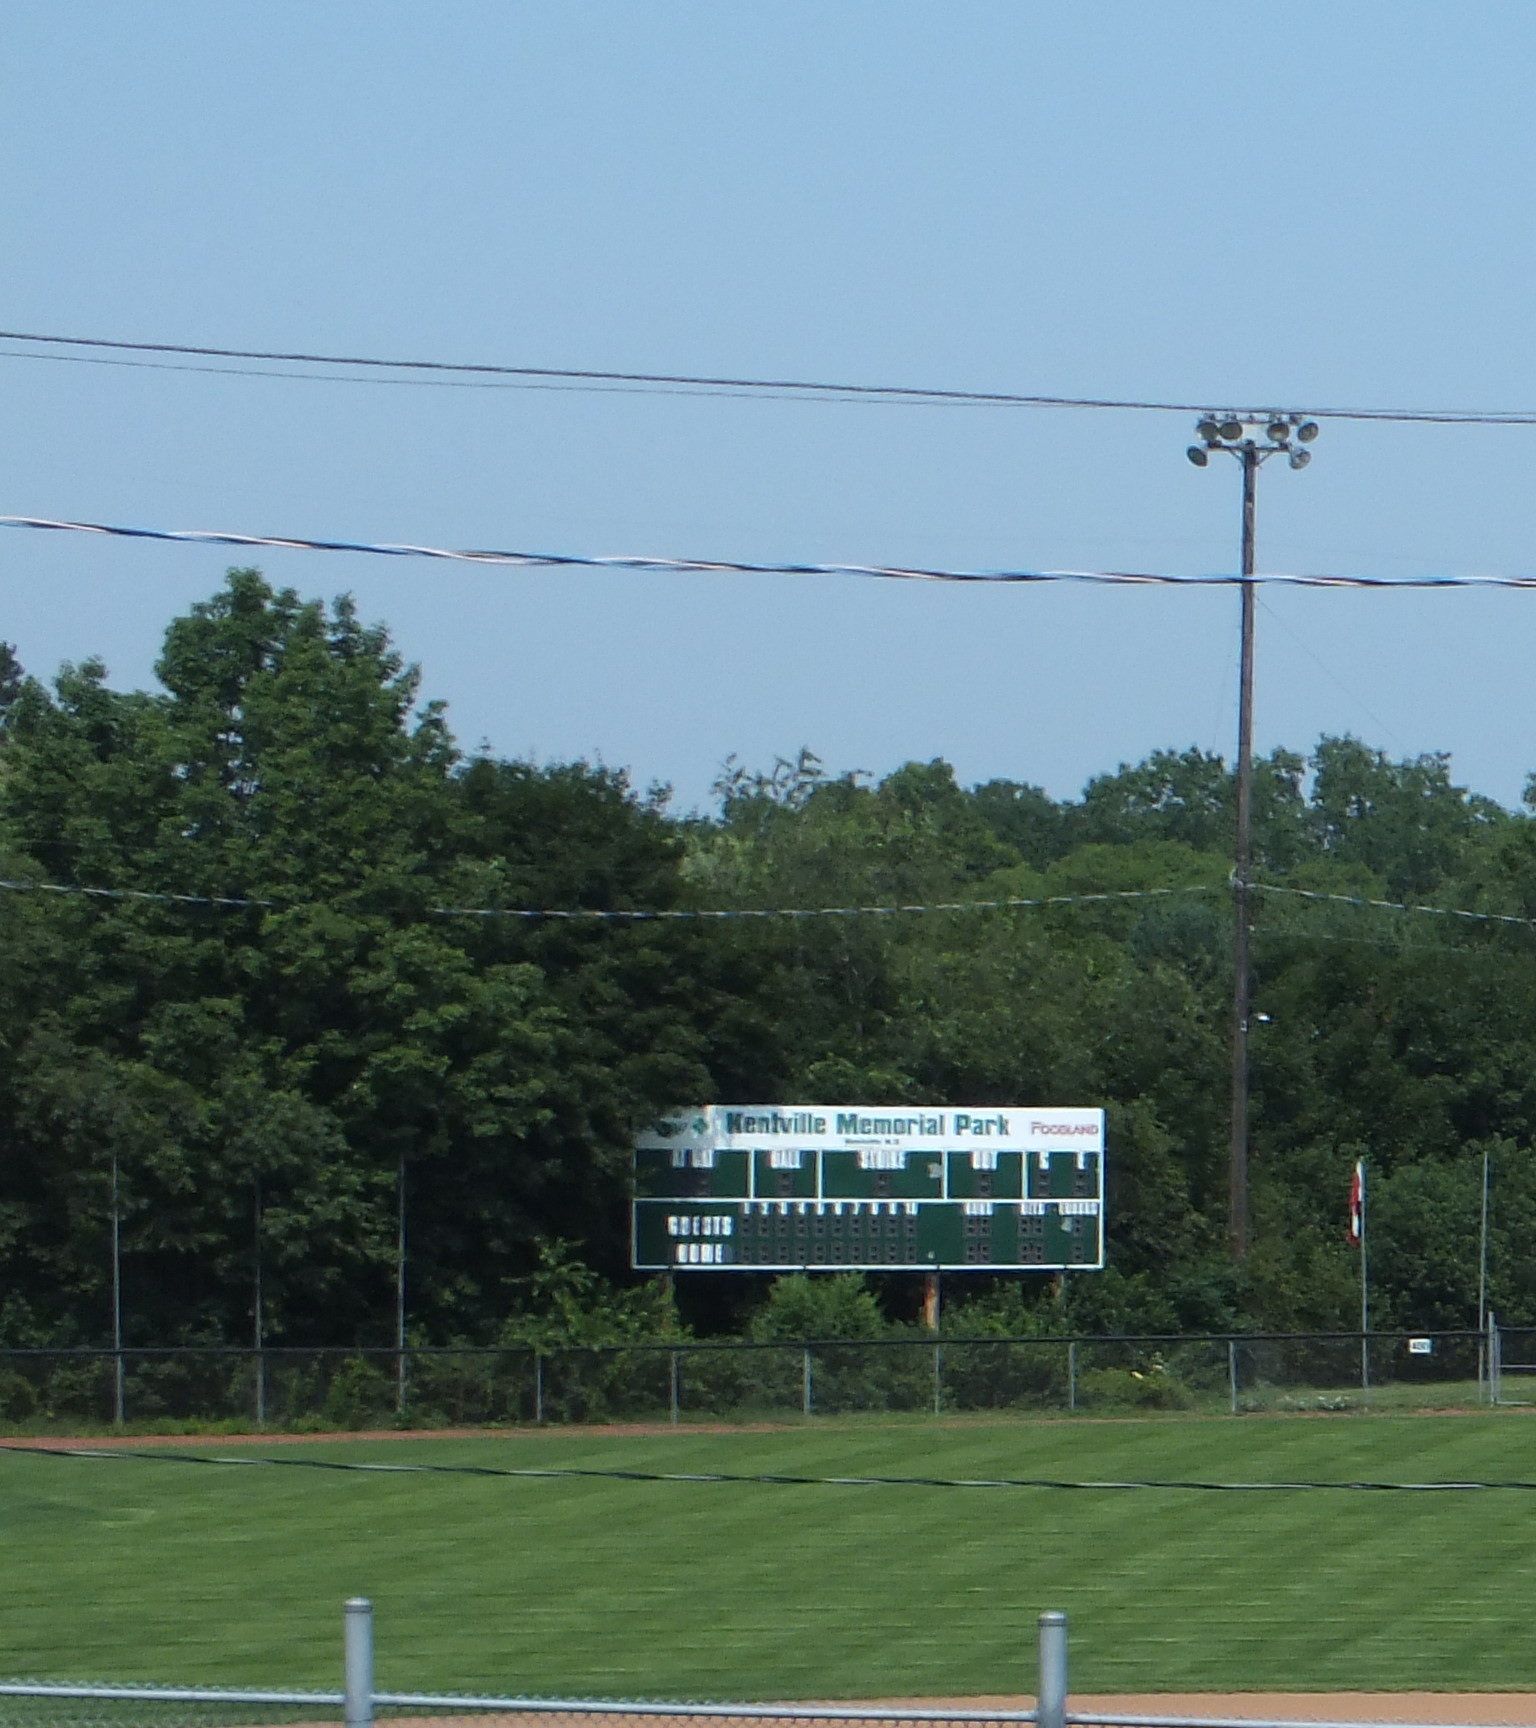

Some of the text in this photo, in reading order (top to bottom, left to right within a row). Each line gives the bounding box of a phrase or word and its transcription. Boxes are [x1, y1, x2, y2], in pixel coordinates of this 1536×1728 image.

[725, 1111, 1011, 1136] Kentville Memorial Park
